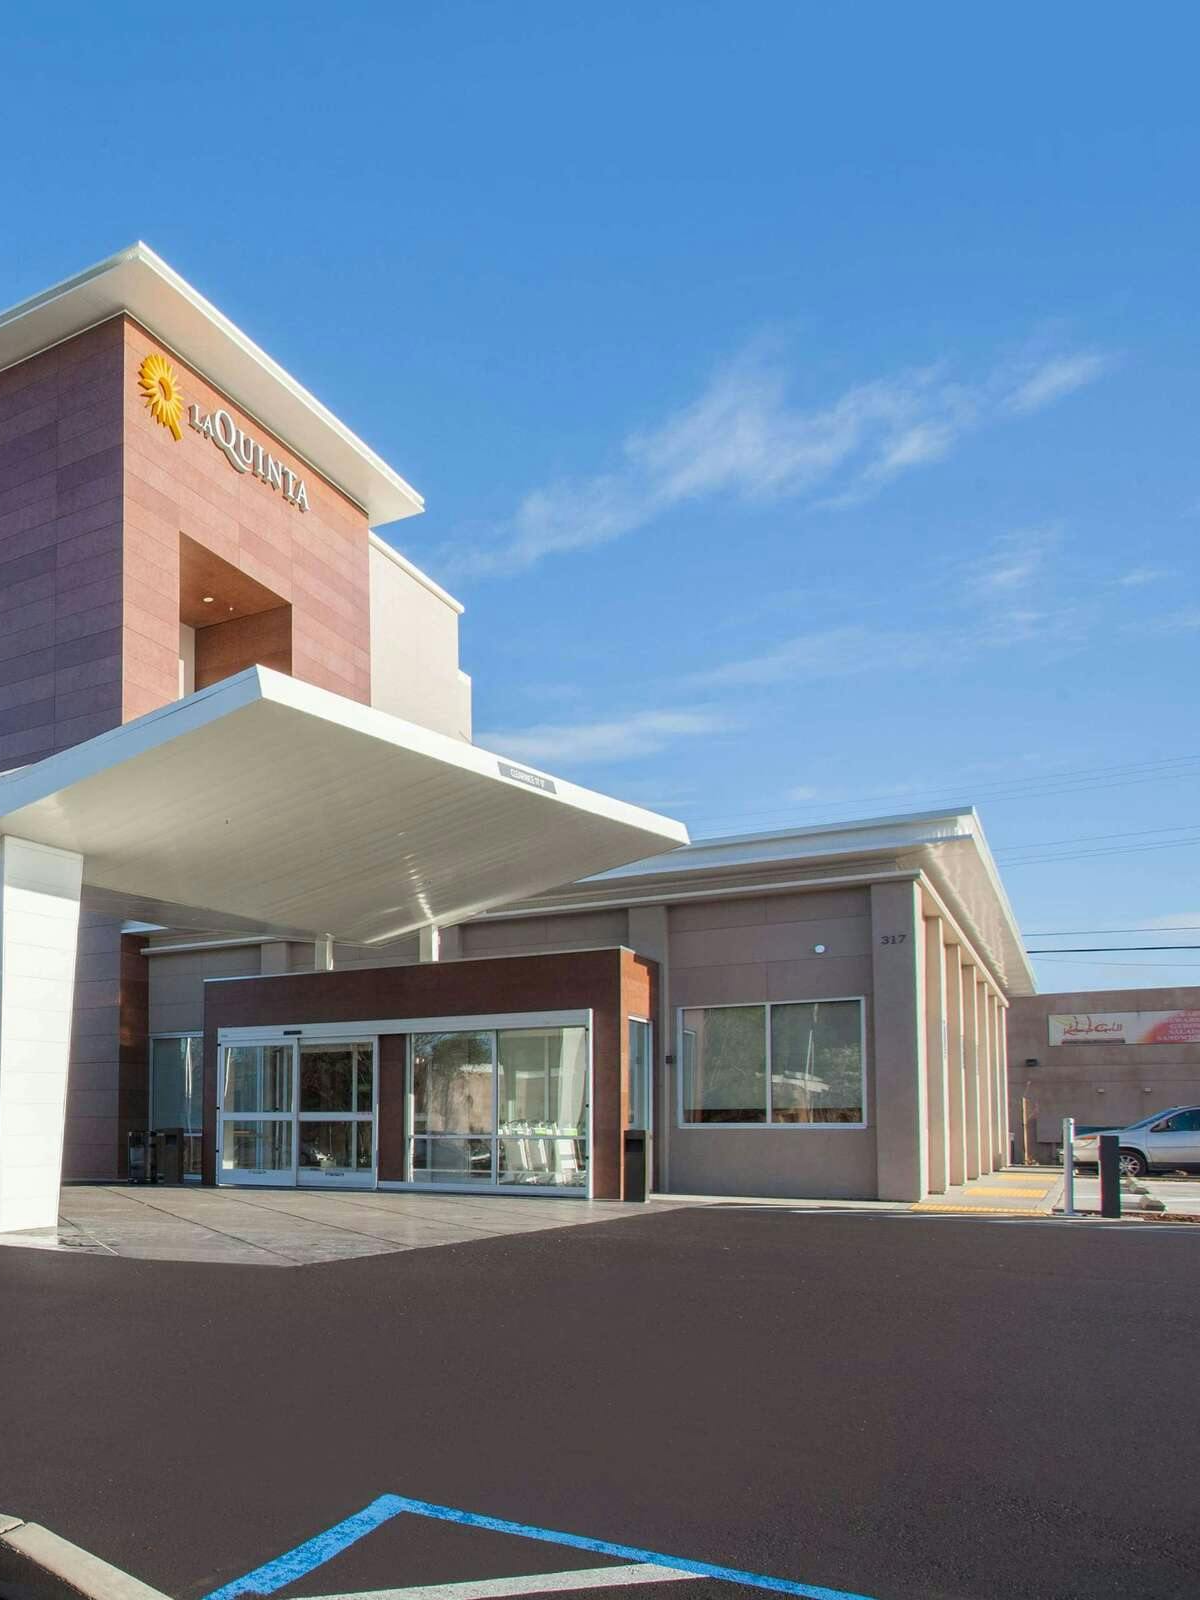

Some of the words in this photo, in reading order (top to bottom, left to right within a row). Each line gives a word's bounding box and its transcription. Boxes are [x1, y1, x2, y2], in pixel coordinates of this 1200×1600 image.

[188, 403, 214, 440] LA
[211, 409, 311, 513] QUINTA
[880, 934, 907, 945] 317
